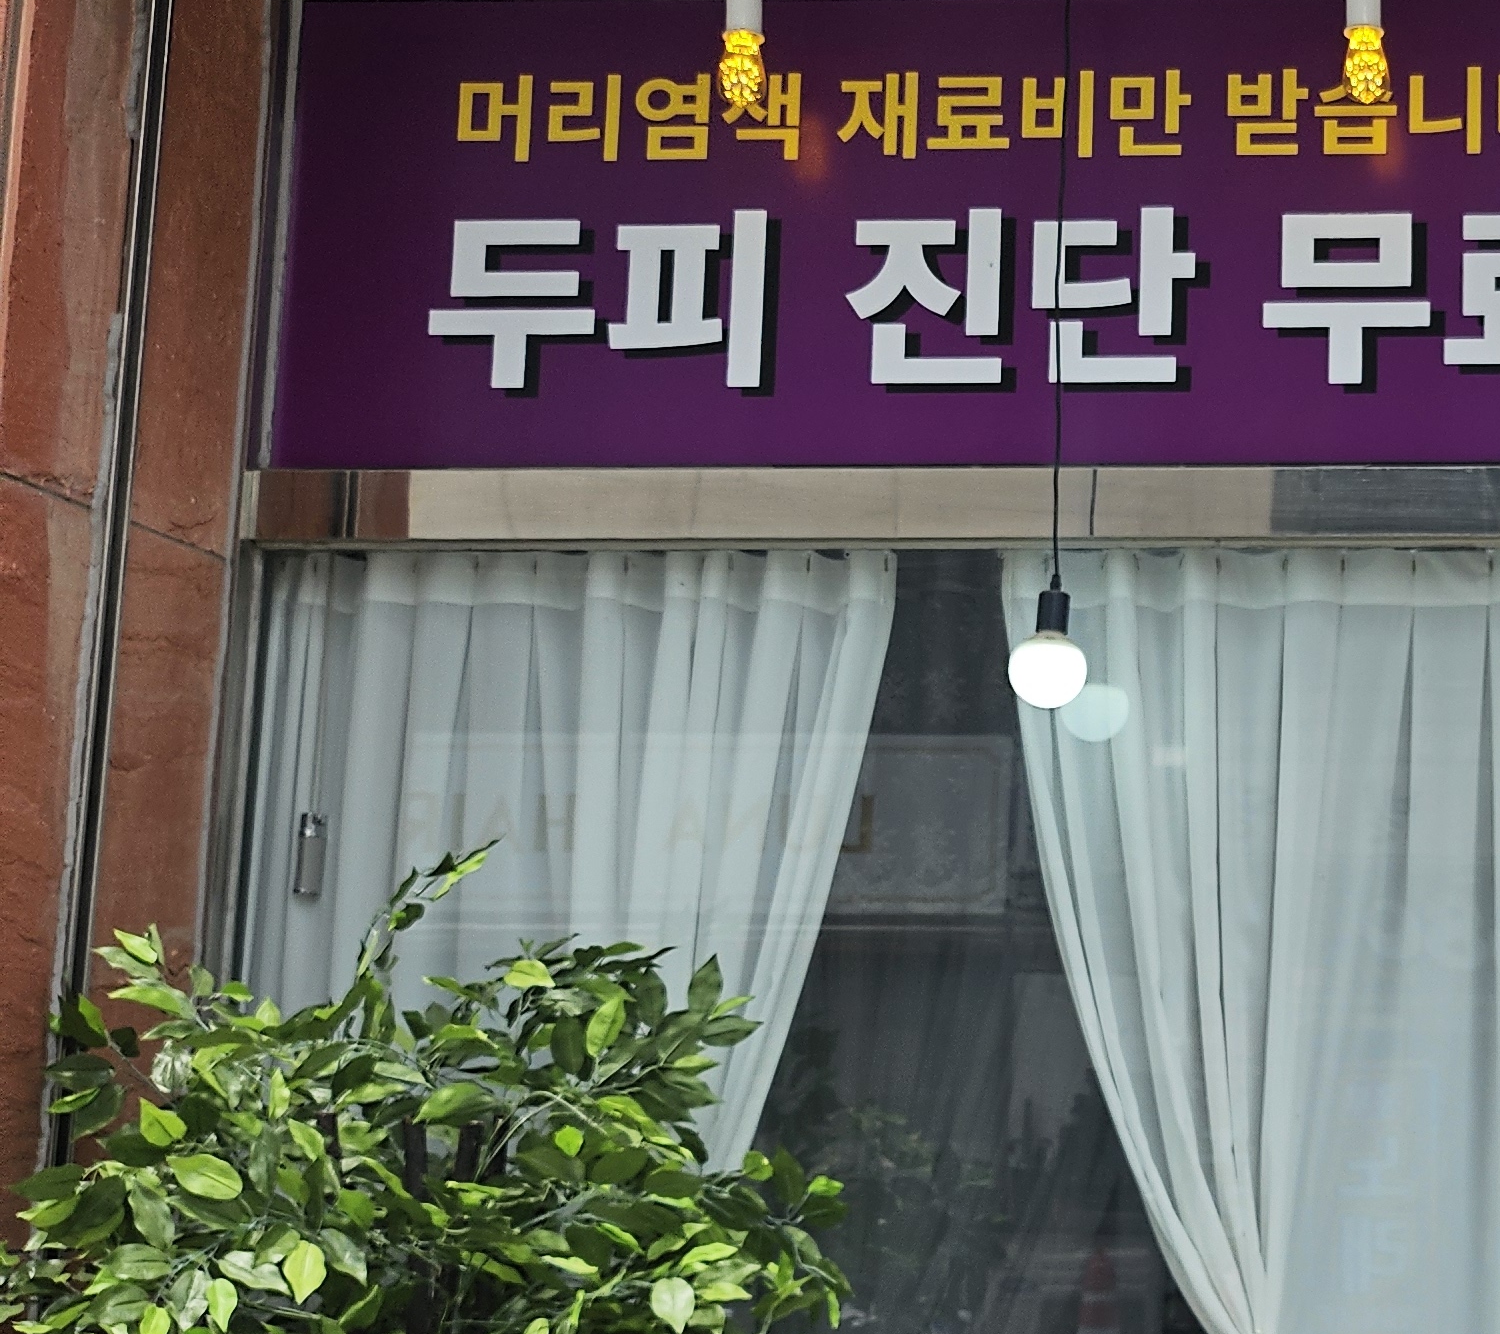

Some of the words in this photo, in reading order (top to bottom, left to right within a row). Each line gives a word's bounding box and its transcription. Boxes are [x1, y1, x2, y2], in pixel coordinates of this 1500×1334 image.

[457, 72, 802, 161] 머리염색
[837, 70, 1192, 158] 재료비만
[428, 209, 769, 389] 두피
[845, 207, 1197, 384] 진단
